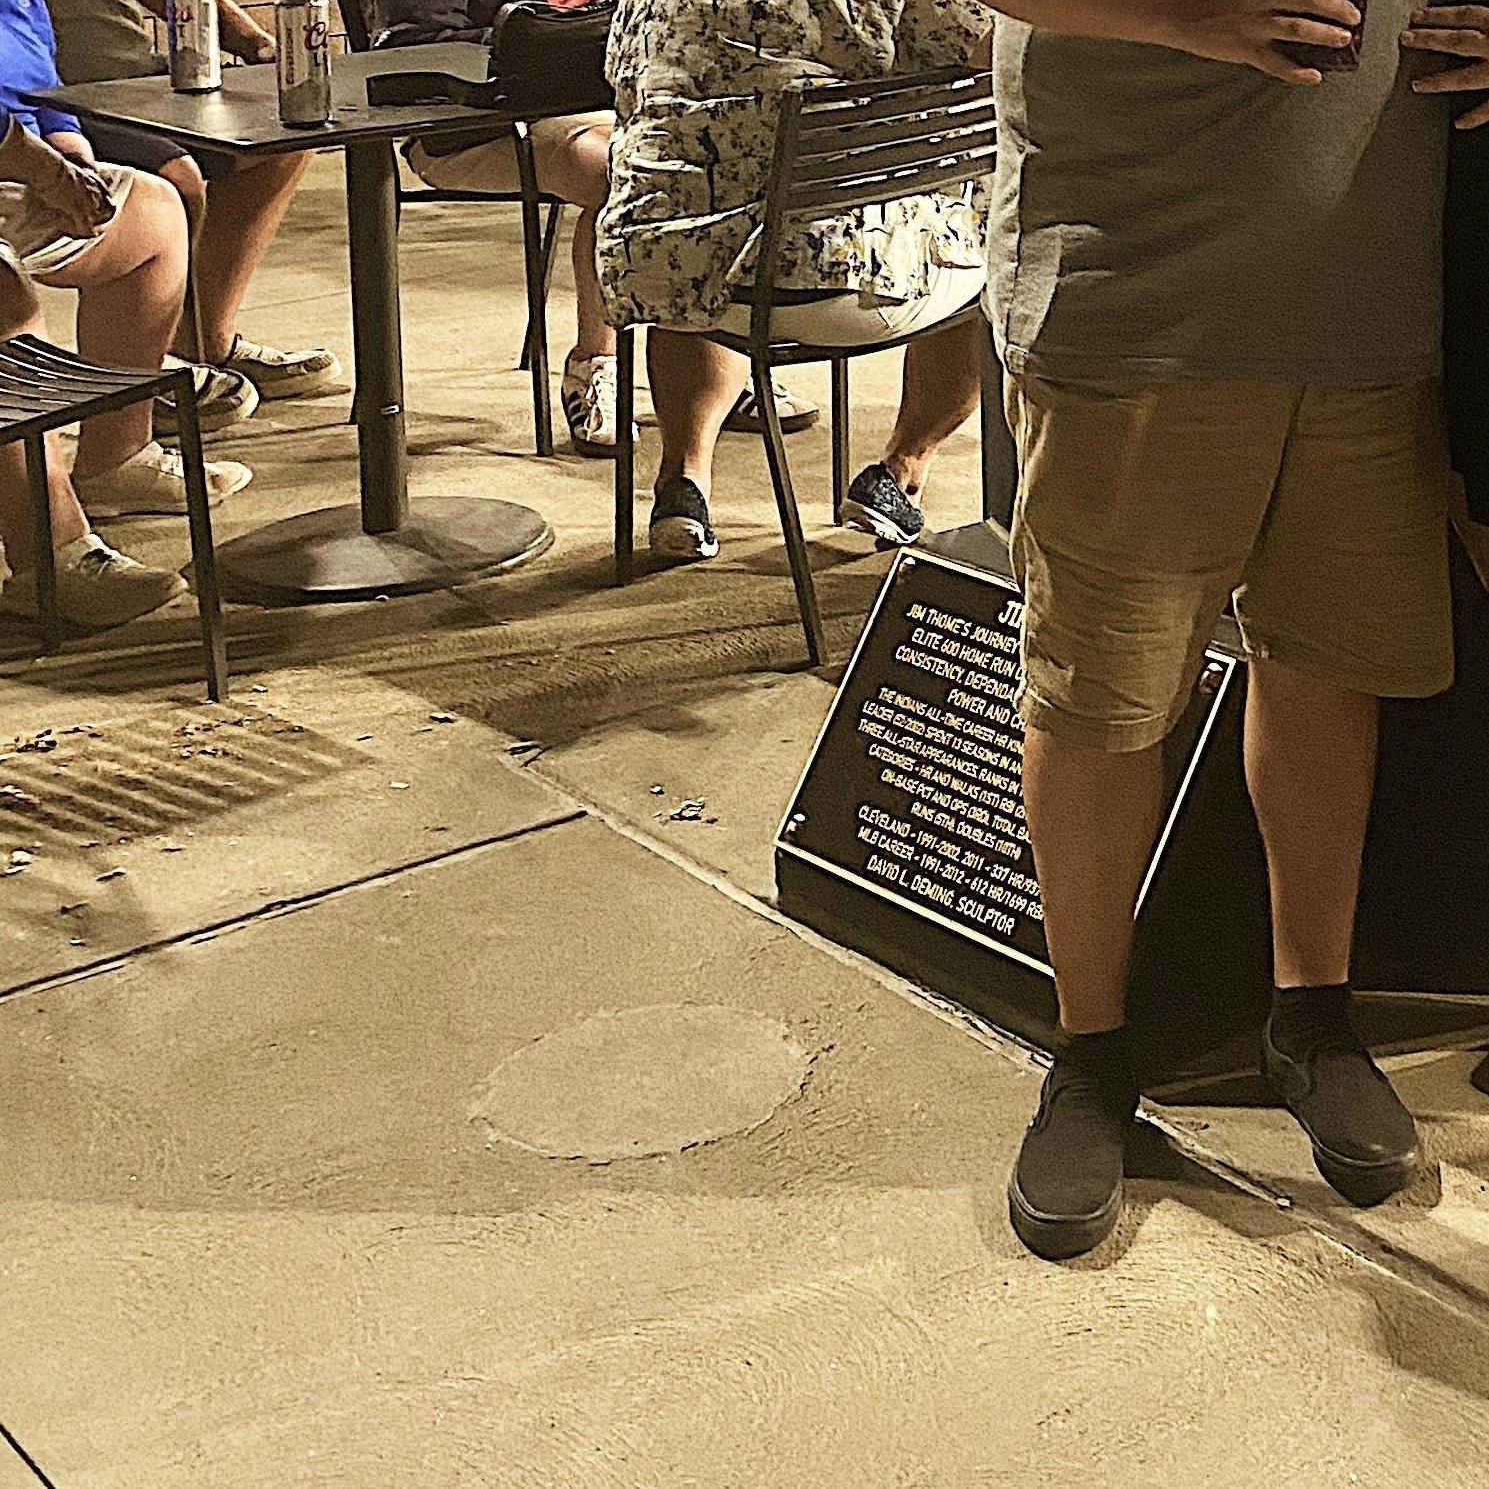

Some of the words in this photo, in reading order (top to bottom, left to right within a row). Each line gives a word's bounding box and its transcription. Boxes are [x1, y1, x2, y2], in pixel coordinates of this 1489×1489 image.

[911, 628, 943, 650] ELITE
[941, 639, 960, 656] 600
[959, 647, 993, 669] HOME
[990, 657, 1017, 678] RUN
[970, 626, 1021, 654] JOURNEY
[947, 688, 987, 715] POWER
[984, 705, 1010, 725] AND
[930, 770, 952, 786] AND
[978, 768, 1010, 790] RANKS
[930, 790, 952, 808] AND
[858, 825, 880, 844] MLB
[878, 835, 915, 861] CAREER
[970, 877, 989, 895] 612
[859, 805, 911, 838] CLEVELAND
[961, 851, 985, 871] 2011
[990, 864, 1010, 881] 337
[867, 854, 900, 881] DAVID
[956, 896, 1016, 935] SCULPTOR
